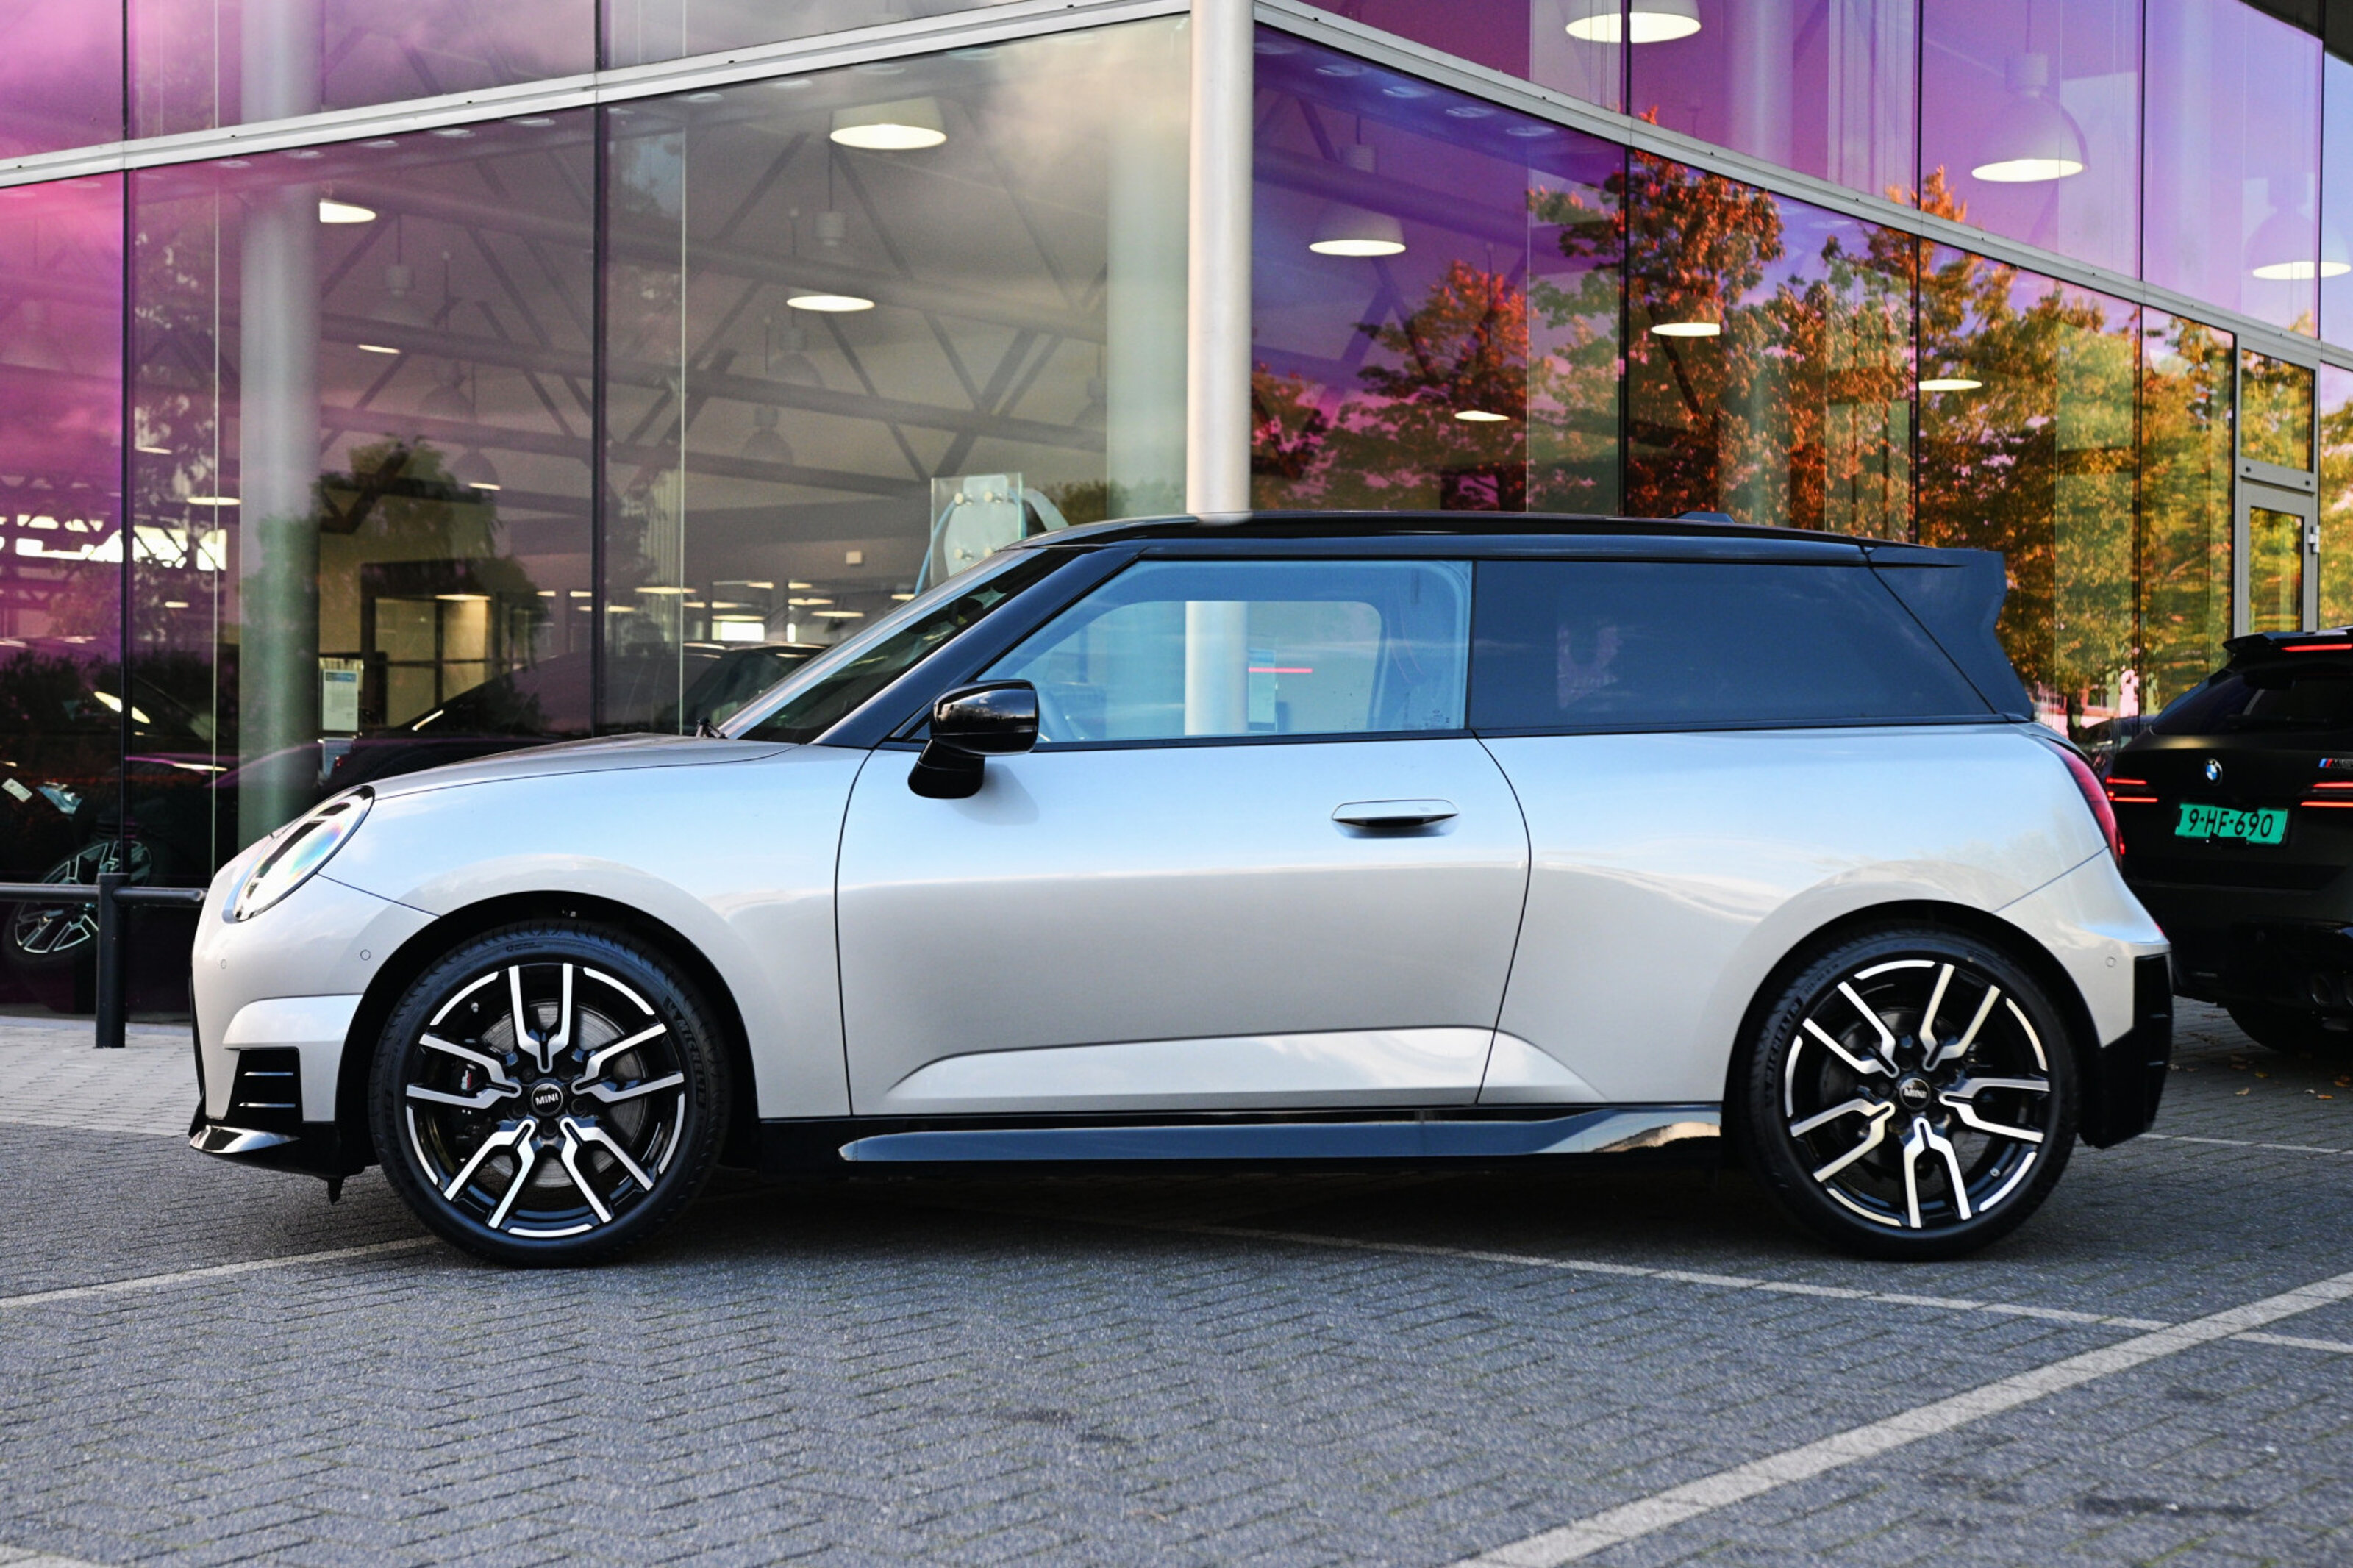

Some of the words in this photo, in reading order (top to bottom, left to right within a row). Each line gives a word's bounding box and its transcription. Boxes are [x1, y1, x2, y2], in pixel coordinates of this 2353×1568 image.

[2189, 809, 2274, 838] 9-HF-690
[676, 1017, 706, 1105] MICHELIN
[535, 1092, 559, 1106] MINI
[1904, 1088, 1927, 1099] MINI
